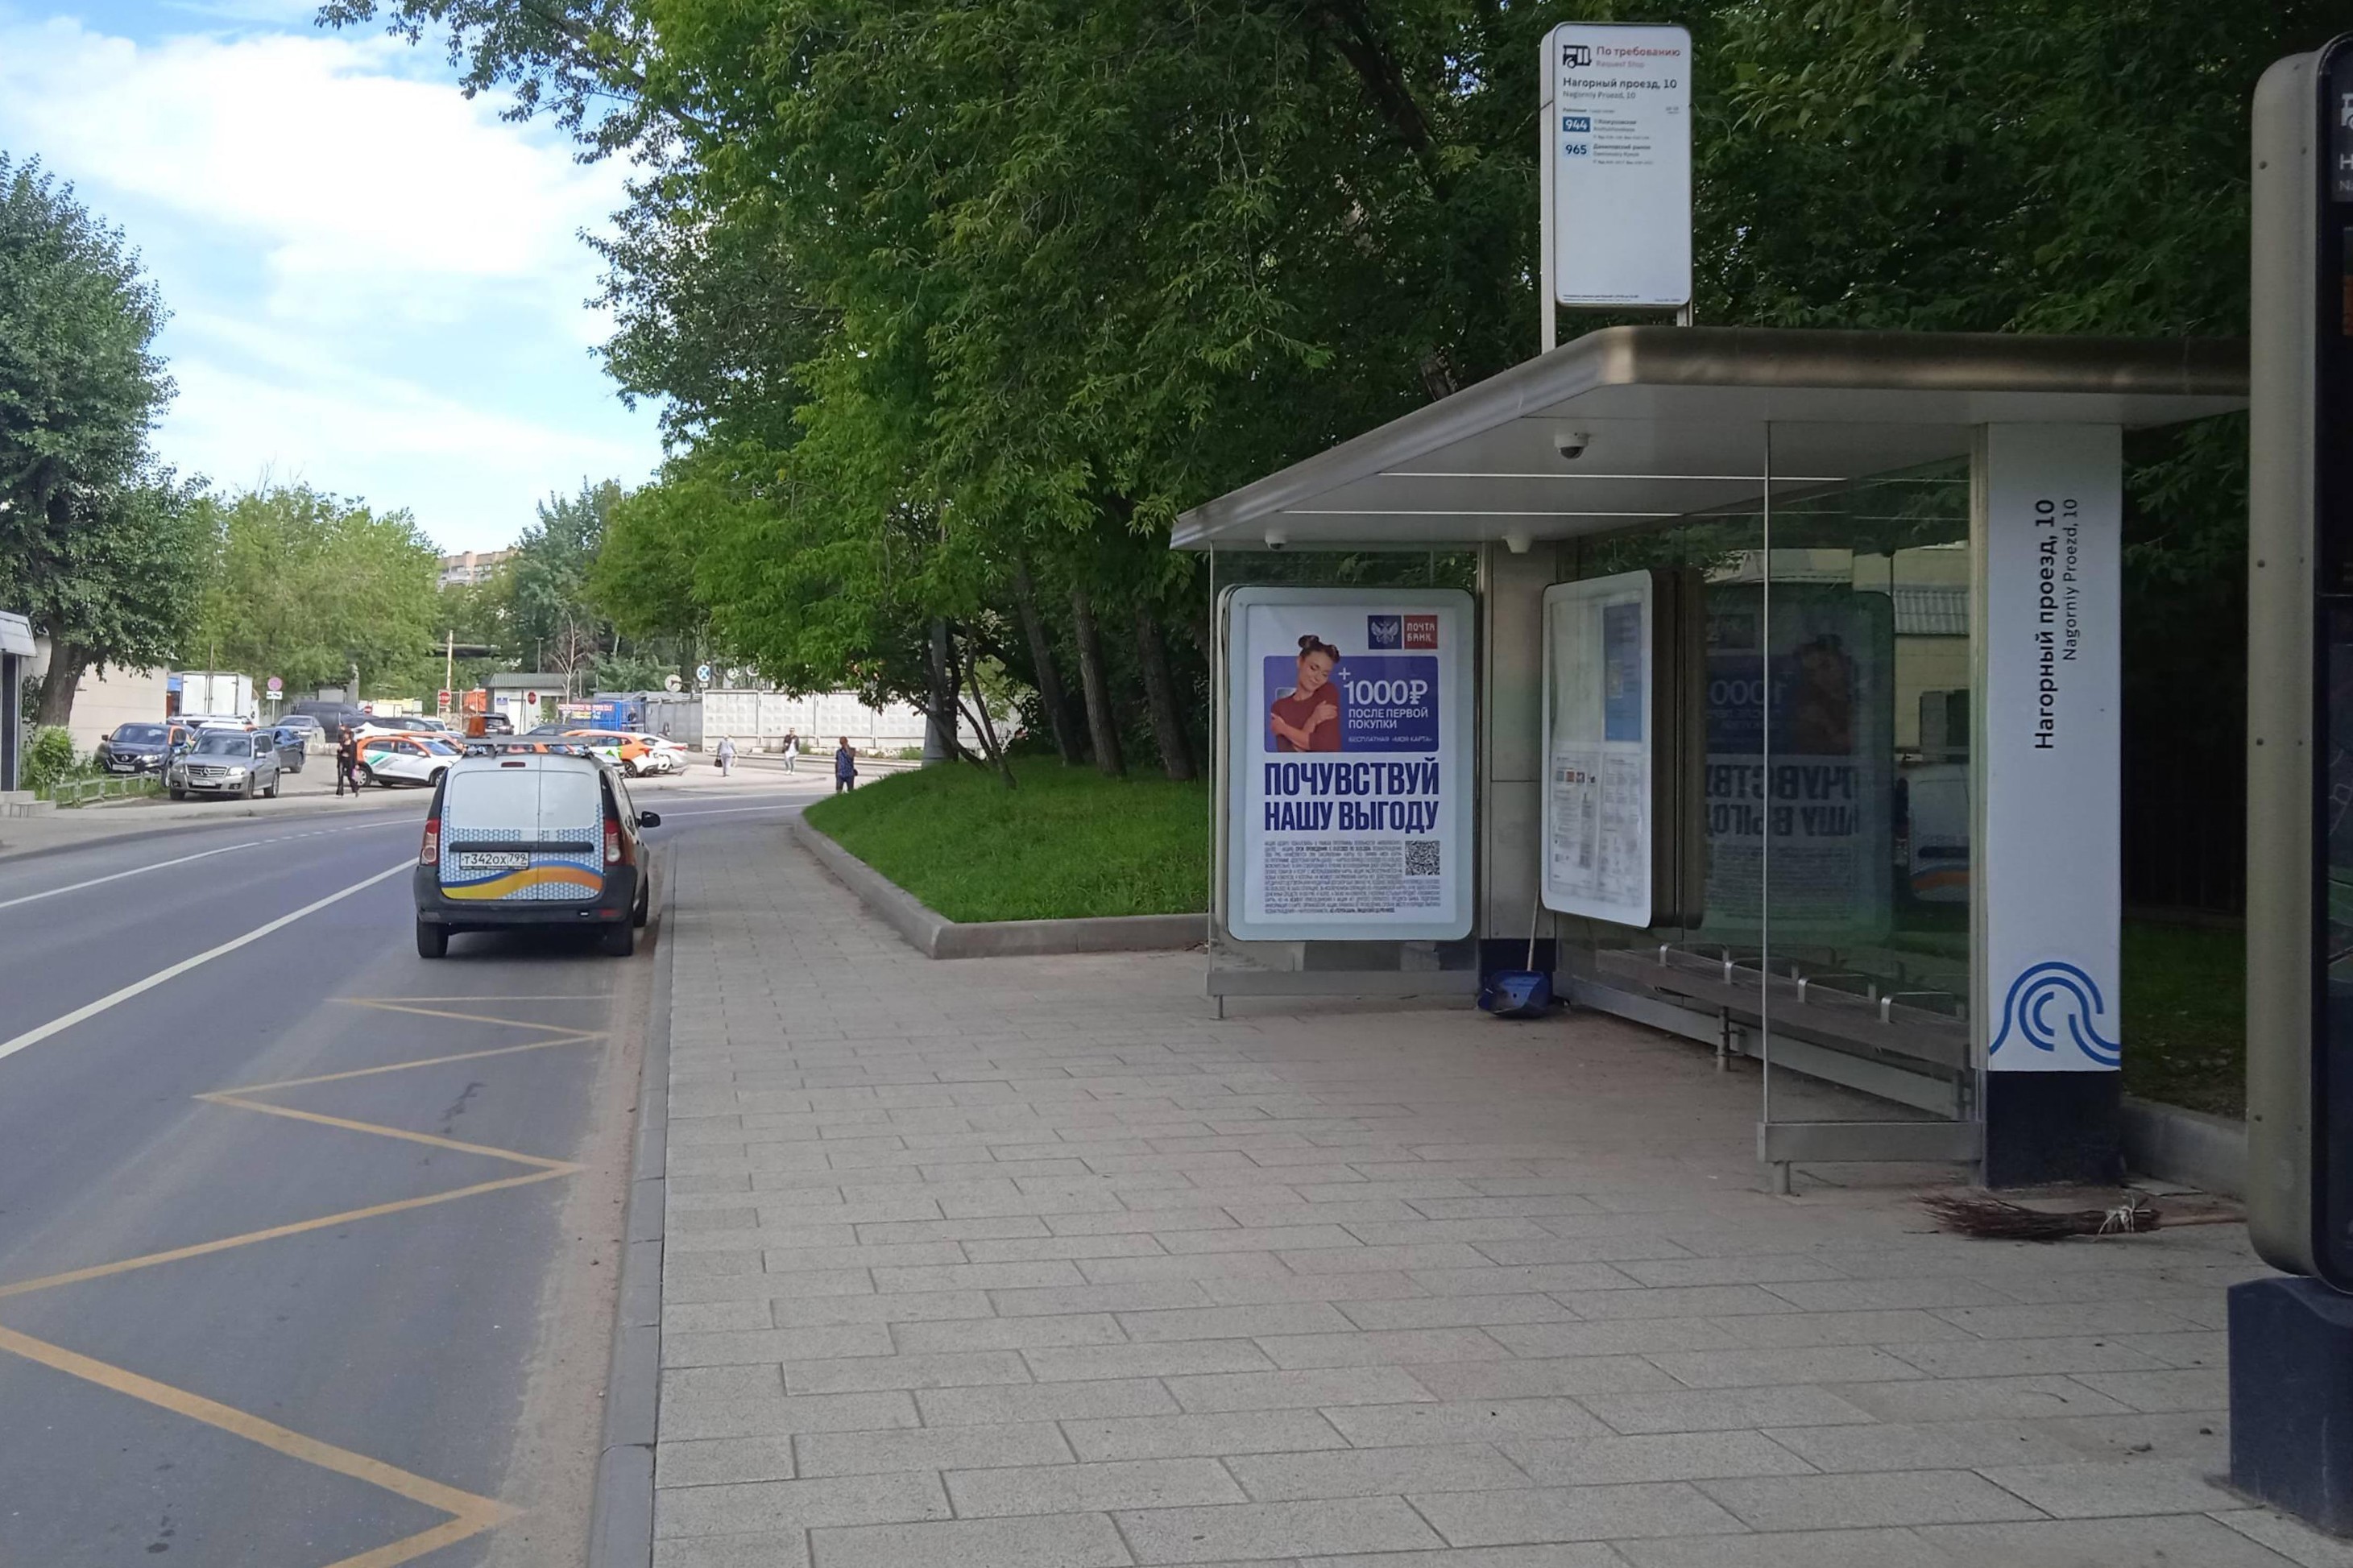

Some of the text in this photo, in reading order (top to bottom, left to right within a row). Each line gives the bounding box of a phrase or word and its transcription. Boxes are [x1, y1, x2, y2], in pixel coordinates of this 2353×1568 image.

[1596, 46, 1681, 57] По требованию
[1562, 77, 1618, 89] Нагорный
[1663, 79, 1678, 89] 10
[1626, 92, 1636, 100] 10
[1565, 119, 1588, 130] 944
[1565, 144, 1587, 155] 965
[2063, 498, 2080, 660] Nagorniy Proezd, 10
[1406, 623, 1435, 631] ПОЧТА
[2035, 499, 2058, 749] Нагорный проезд, 10
[1406, 633, 1432, 642] БАНК
[1348, 707, 1428, 718] ПОСЛЕ ПЕРВОЙ
[1348, 719, 1398, 729] ПОКУПКИ
[1265, 756, 1439, 796] ПОЧУВСТВУЙ
[1265, 801, 1439, 834] НАШУ ВЫГОДУ
